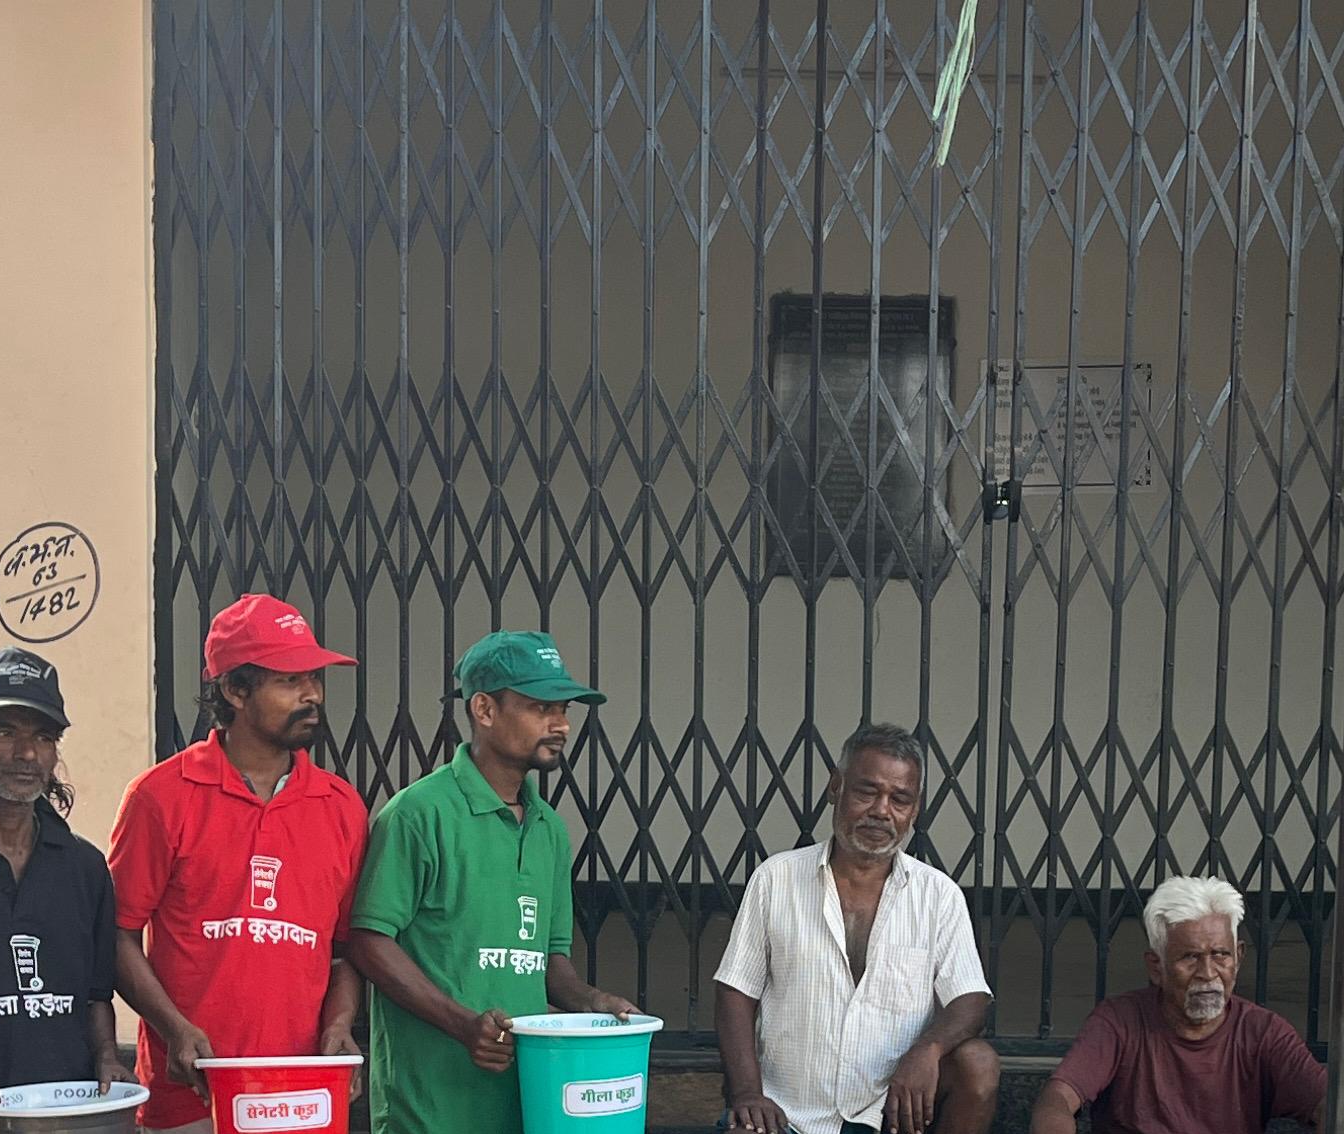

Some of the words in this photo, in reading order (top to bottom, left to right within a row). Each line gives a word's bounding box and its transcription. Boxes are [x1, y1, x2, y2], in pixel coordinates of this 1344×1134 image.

[19, 586, 81, 624] 1482
[201, 917, 245, 939] लाल
[247, 917, 317, 950] कूड़ादान
[478, 947, 508, 970] हरा
[22, 992, 74, 1018] कूड़दान
[592, 1019, 631, 1028] POO
[580, 1088, 613, 1103] गीला
[246, 1103, 290, 1119] सेनेटरी
